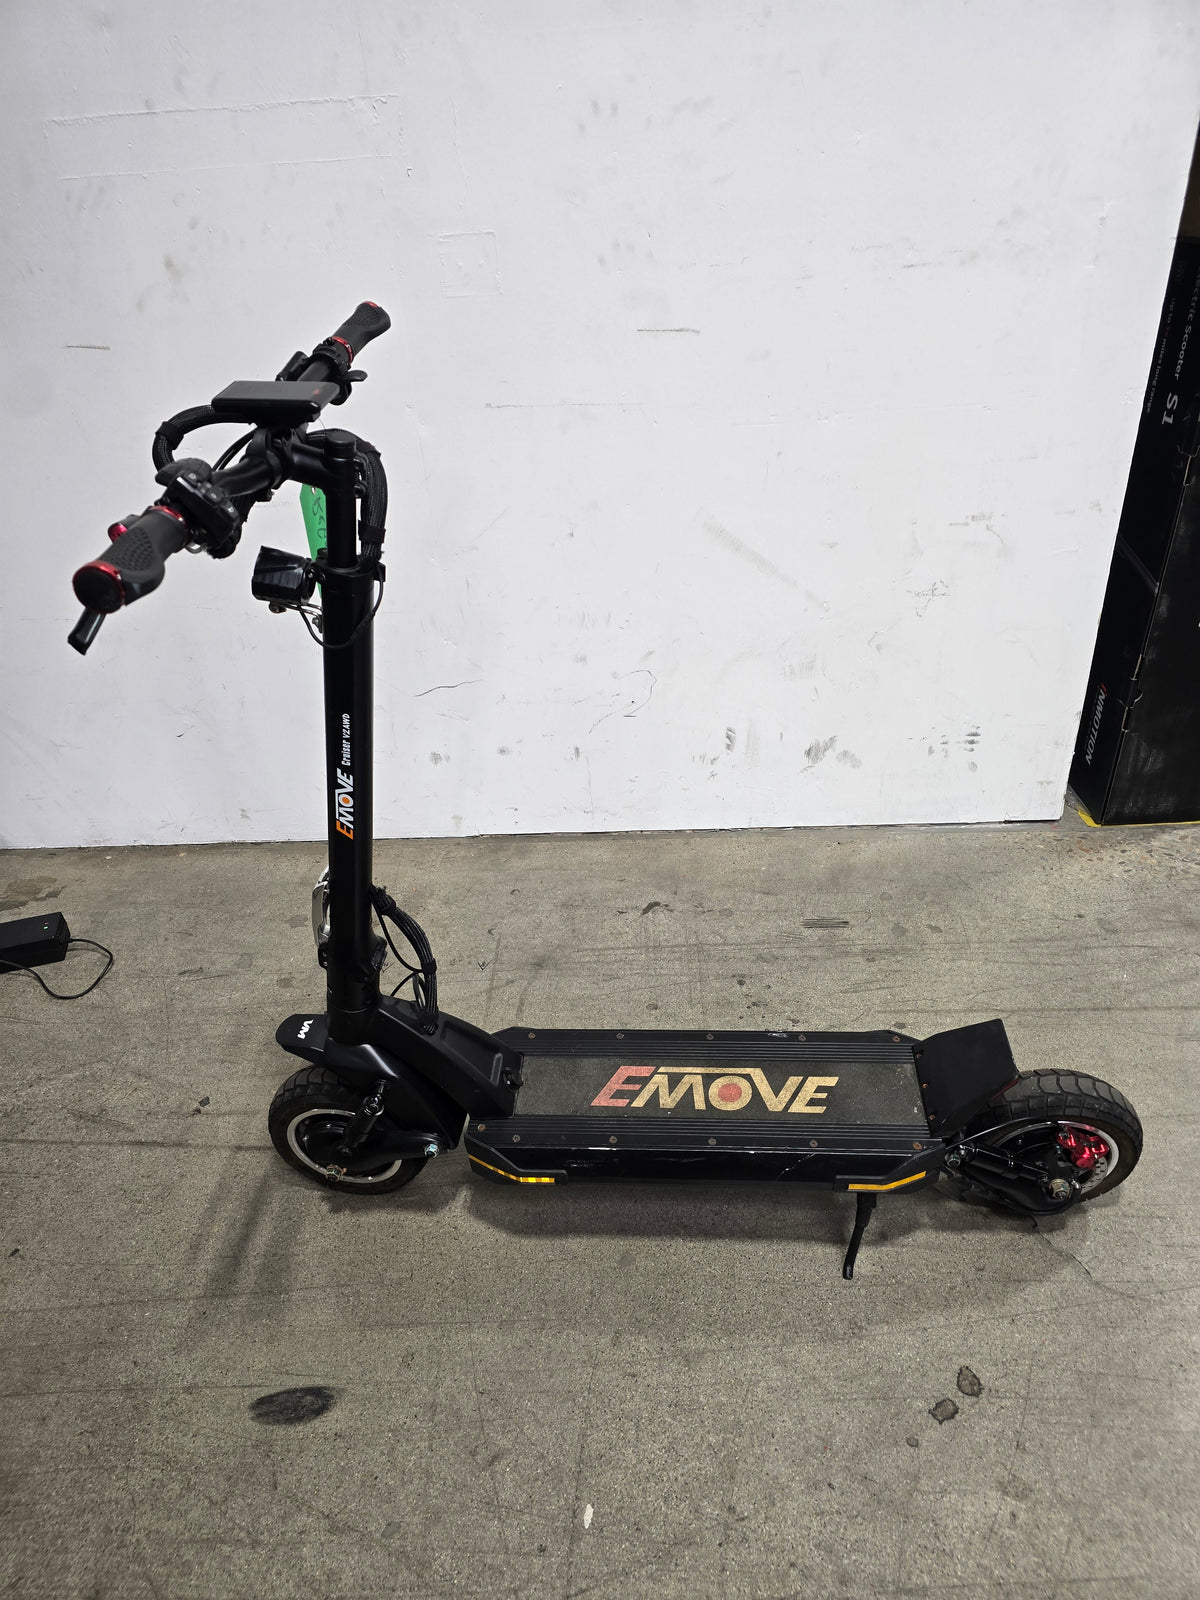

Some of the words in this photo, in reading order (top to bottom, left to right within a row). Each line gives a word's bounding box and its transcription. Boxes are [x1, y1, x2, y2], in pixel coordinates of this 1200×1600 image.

[1188, 265, 1200, 321] lectric
[1158, 338, 1167, 364] miles
[1174, 325, 1192, 380] Scooter
[1151, 365, 1161, 386] long
[1146, 387, 1156, 413] range
[1162, 392, 1179, 424] S1
[1085, 682, 1107, 765] INMOTION
[341, 739, 351, 766] Cruiser
[335, 767, 354, 840] EMOVE
[590, 1065, 839, 1114] EMOVE
